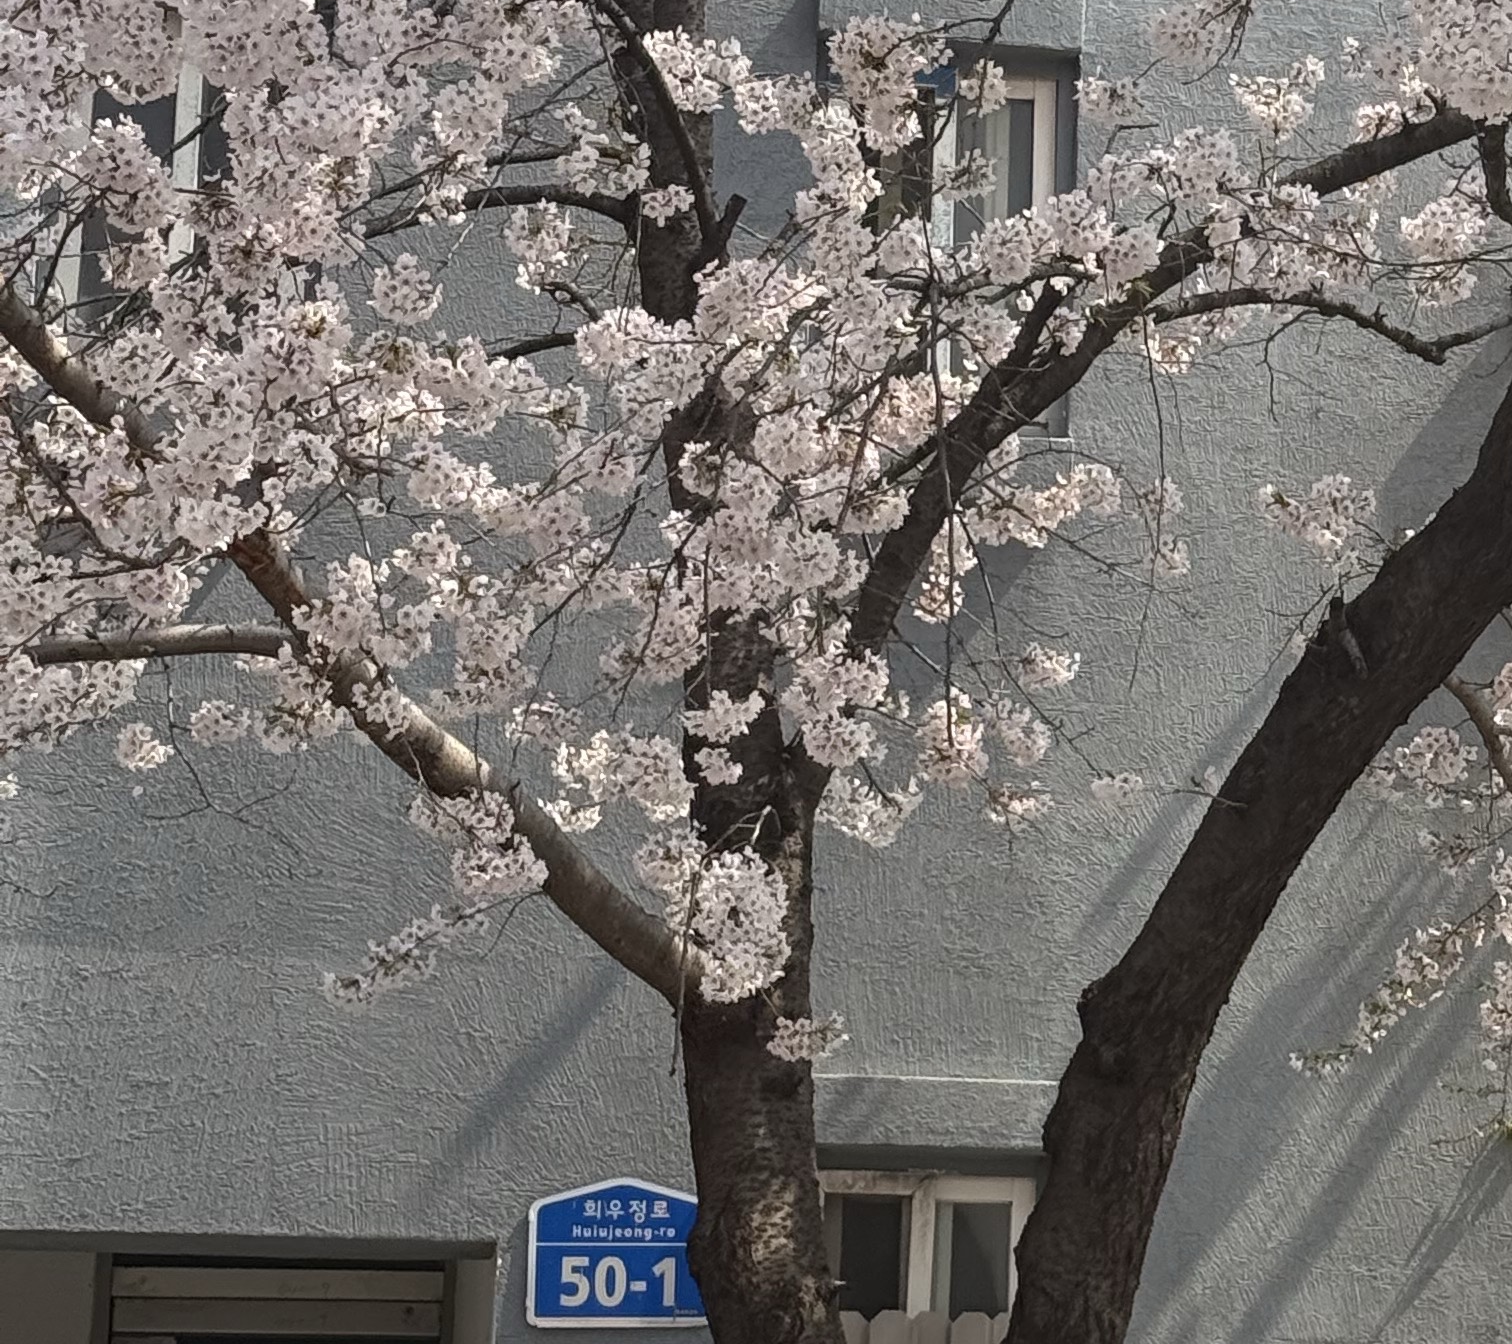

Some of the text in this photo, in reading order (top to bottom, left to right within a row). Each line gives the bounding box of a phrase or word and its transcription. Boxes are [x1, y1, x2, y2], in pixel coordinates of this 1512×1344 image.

[583, 1199, 671, 1224] 희우정로
[572, 1224, 676, 1241] Huiujeong-ro
[560, 1256, 676, 1307] 50-1
